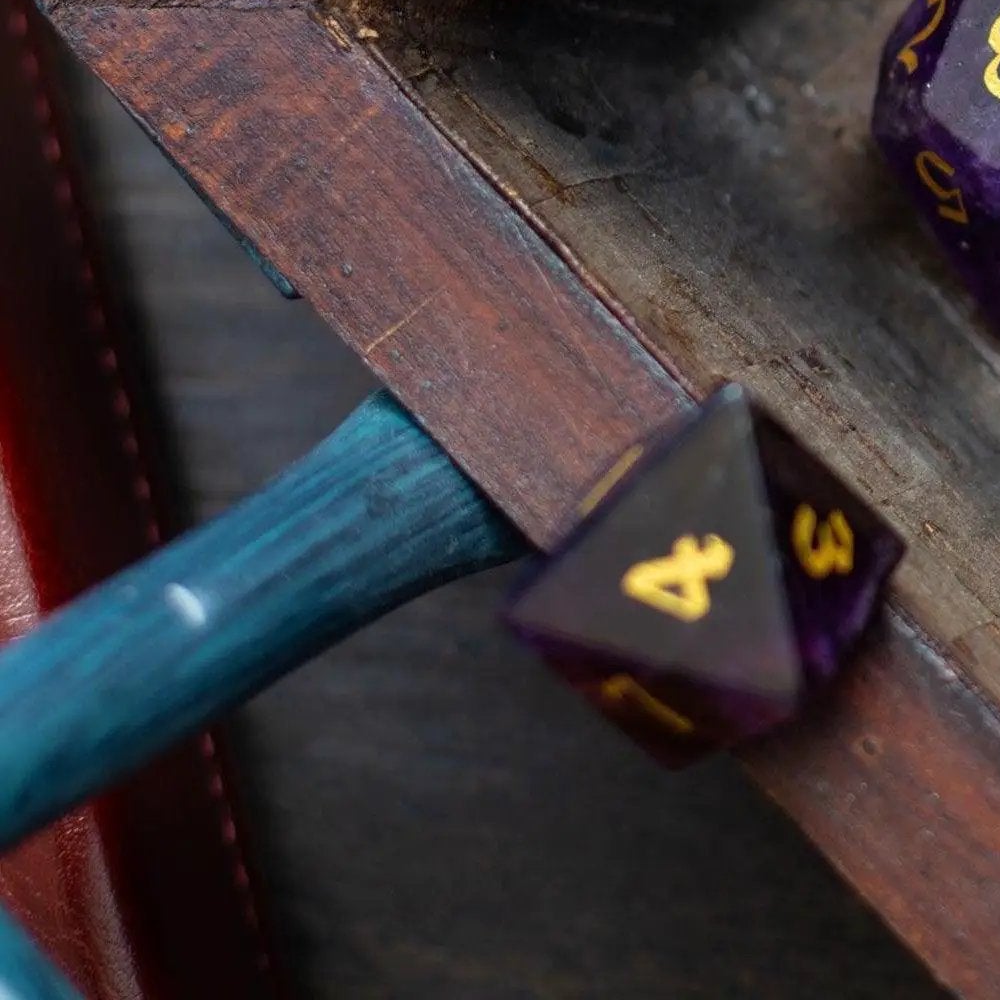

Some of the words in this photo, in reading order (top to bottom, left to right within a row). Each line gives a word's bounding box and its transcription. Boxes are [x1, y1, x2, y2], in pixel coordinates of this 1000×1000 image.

[915, 150, 969, 224] 5
[619, 530, 736, 623] 4
[791, 503, 856, 580] 3
